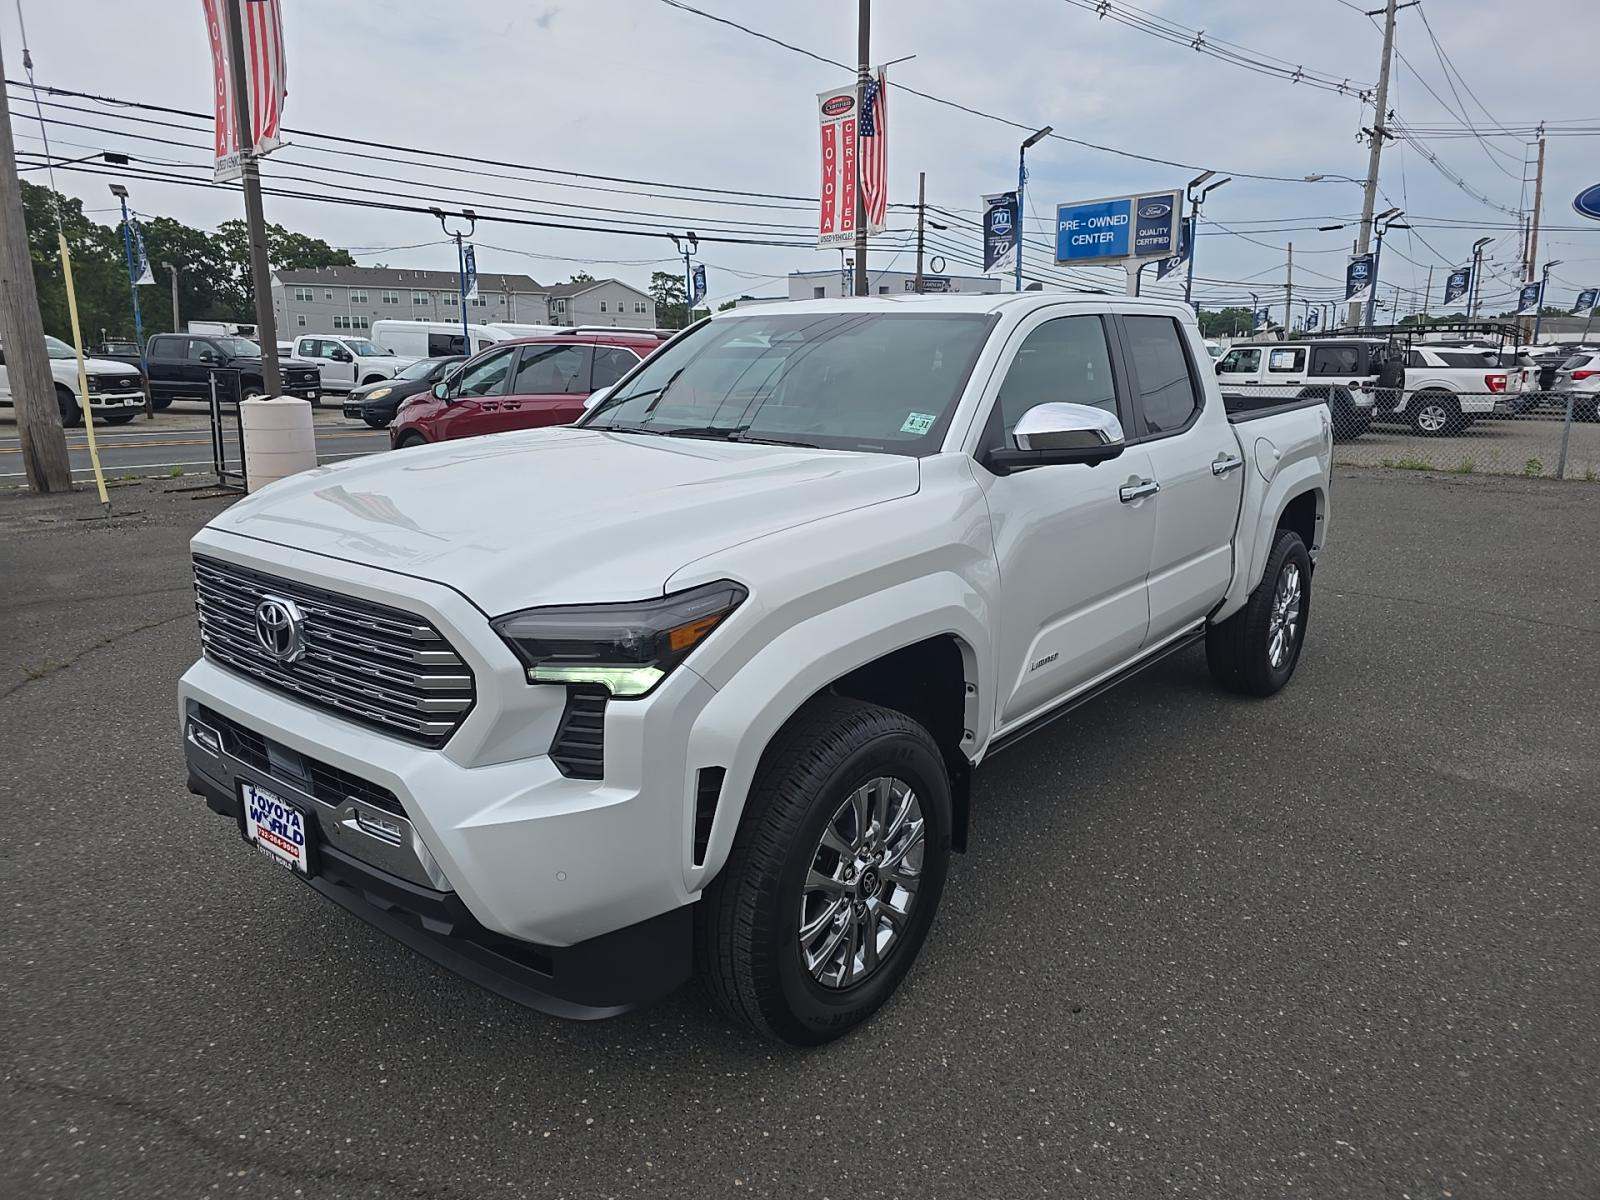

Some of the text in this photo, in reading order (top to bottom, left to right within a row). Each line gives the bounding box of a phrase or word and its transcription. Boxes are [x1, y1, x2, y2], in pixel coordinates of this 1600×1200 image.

[824, 129, 834, 229] TOYOTA
[843, 122, 853, 228] CERTIFIED
[993, 212, 1008, 224] 70
[1071, 231, 1115, 246] CENTER
[1139, 227, 1168, 237] QUALITY
[992, 241, 1010, 256] 70
[1136, 236, 1170, 247] CERTIFIED
[1353, 283, 1365, 292] 70
[248, 787, 301, 830] TOYOTA
